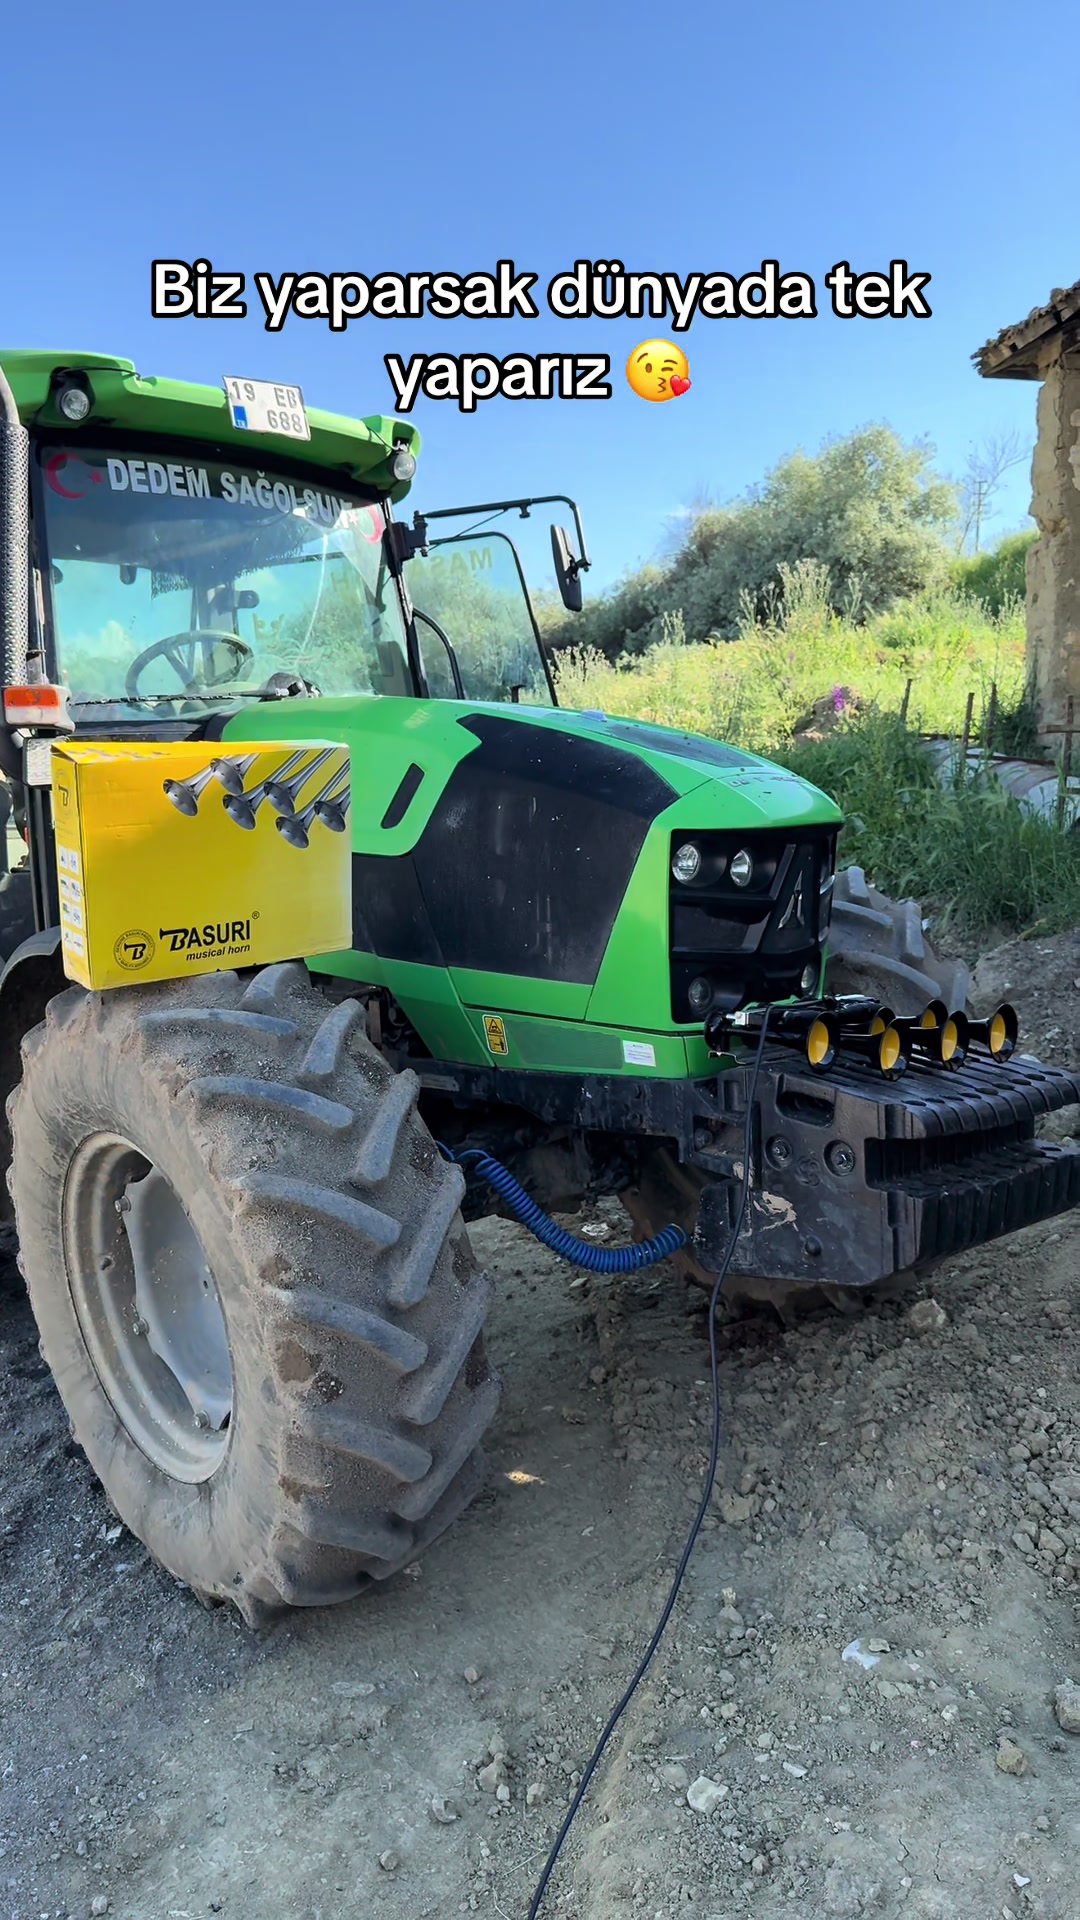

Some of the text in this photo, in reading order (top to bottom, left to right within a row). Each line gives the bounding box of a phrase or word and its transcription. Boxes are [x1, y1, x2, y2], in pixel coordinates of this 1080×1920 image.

[232, 381, 256, 402] 19
[267, 409, 303, 433] 688
[106, 458, 211, 499] DEDEM
[186, 944, 251, 961] musical horn
